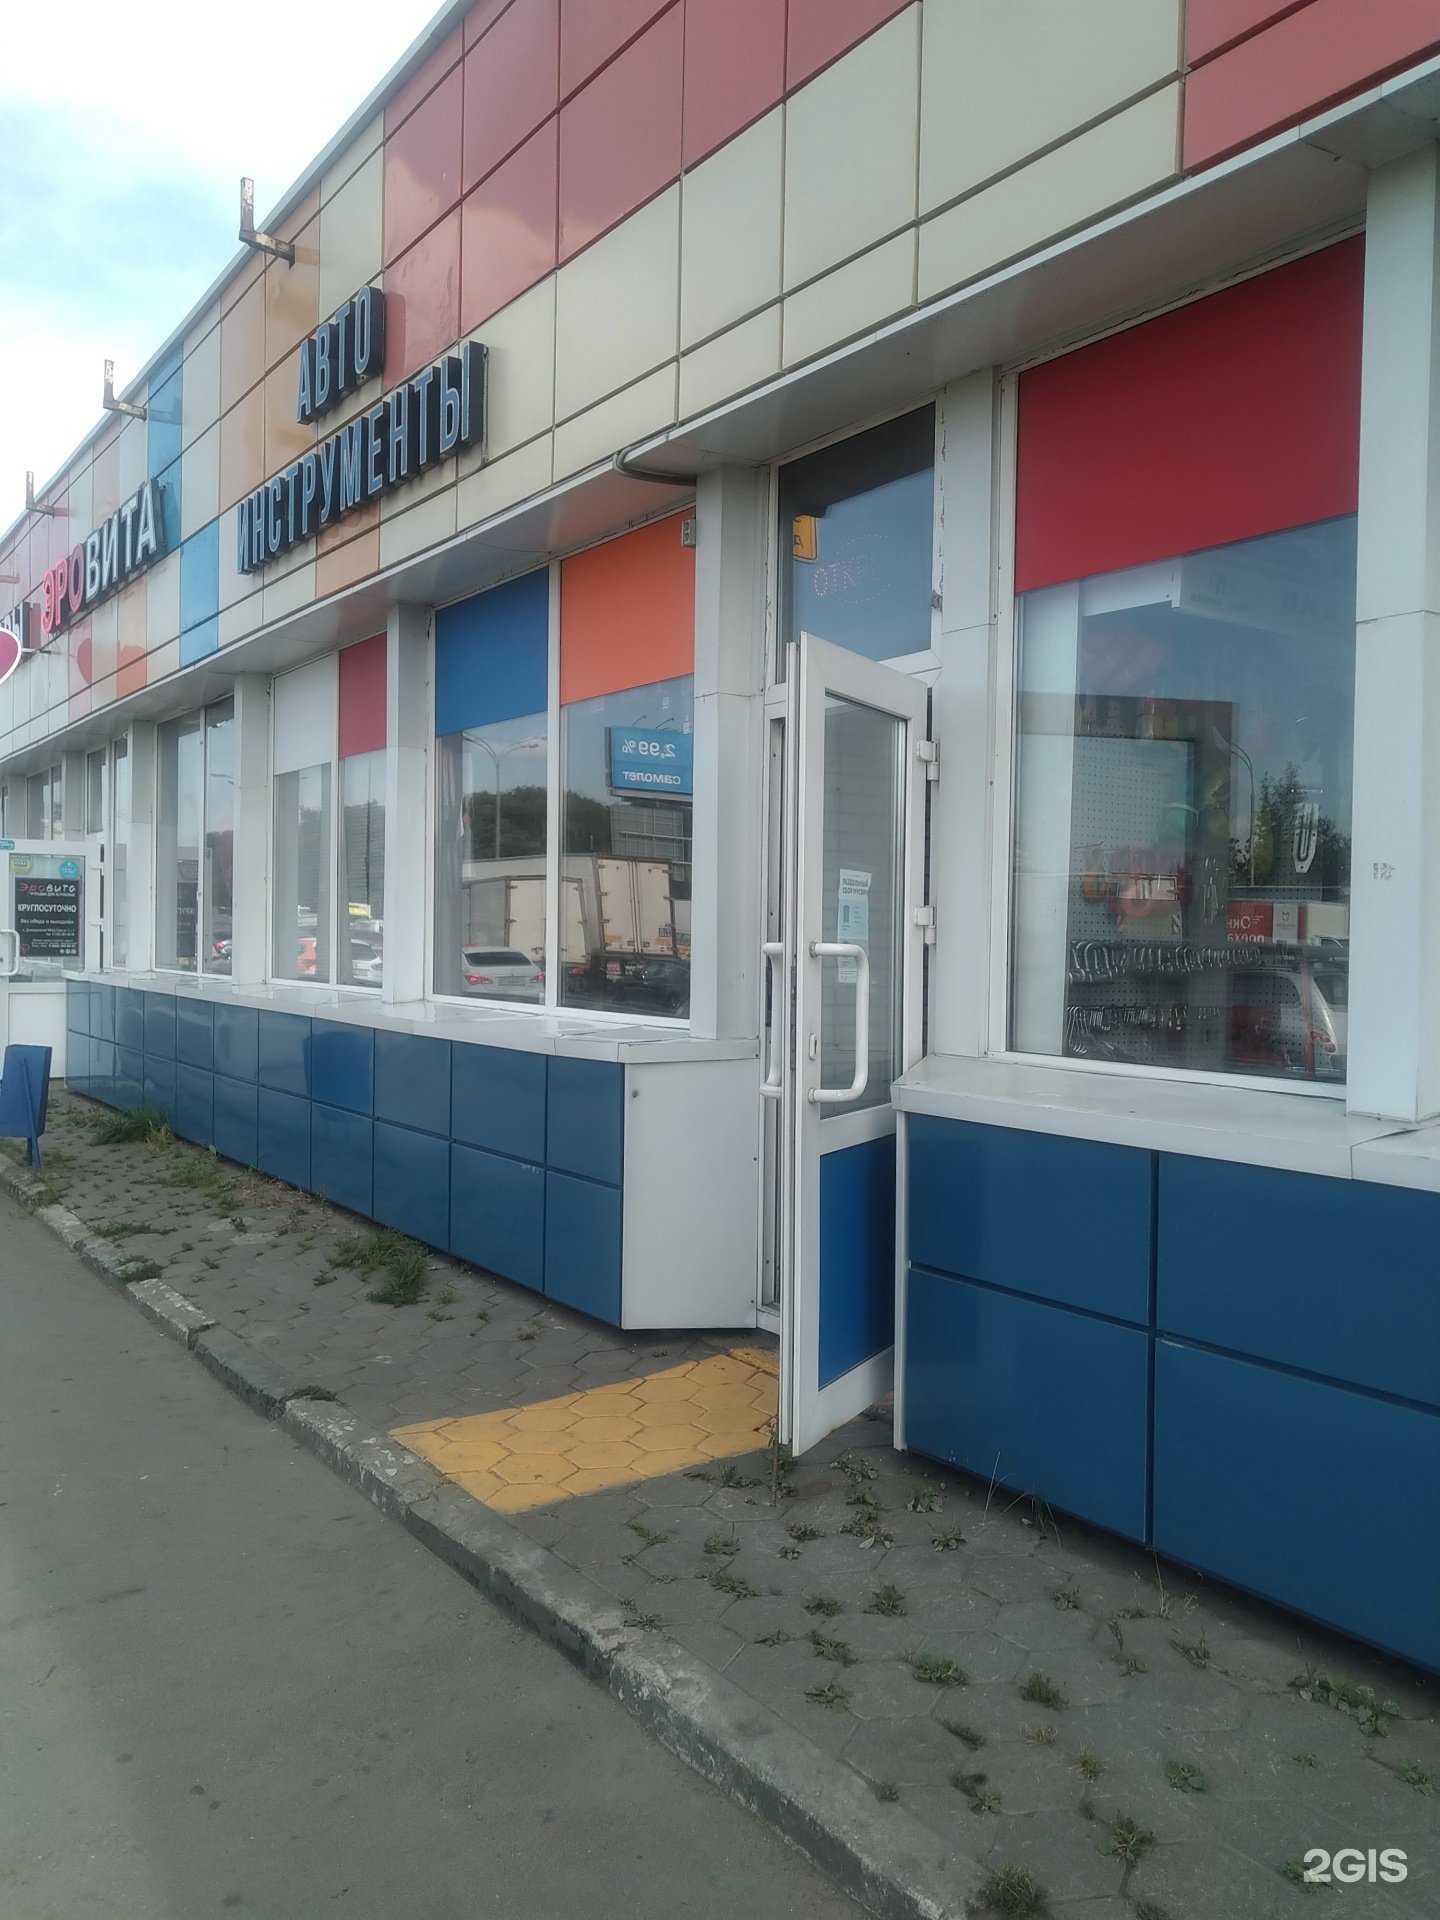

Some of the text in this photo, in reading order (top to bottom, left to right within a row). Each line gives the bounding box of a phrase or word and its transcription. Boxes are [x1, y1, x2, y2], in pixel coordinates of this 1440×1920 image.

[296, 286, 381, 424] АВТО
[236, 340, 478, 574] ИНСТРУМЕНТЫ
[41, 481, 160, 634] ЭРОВИТА
